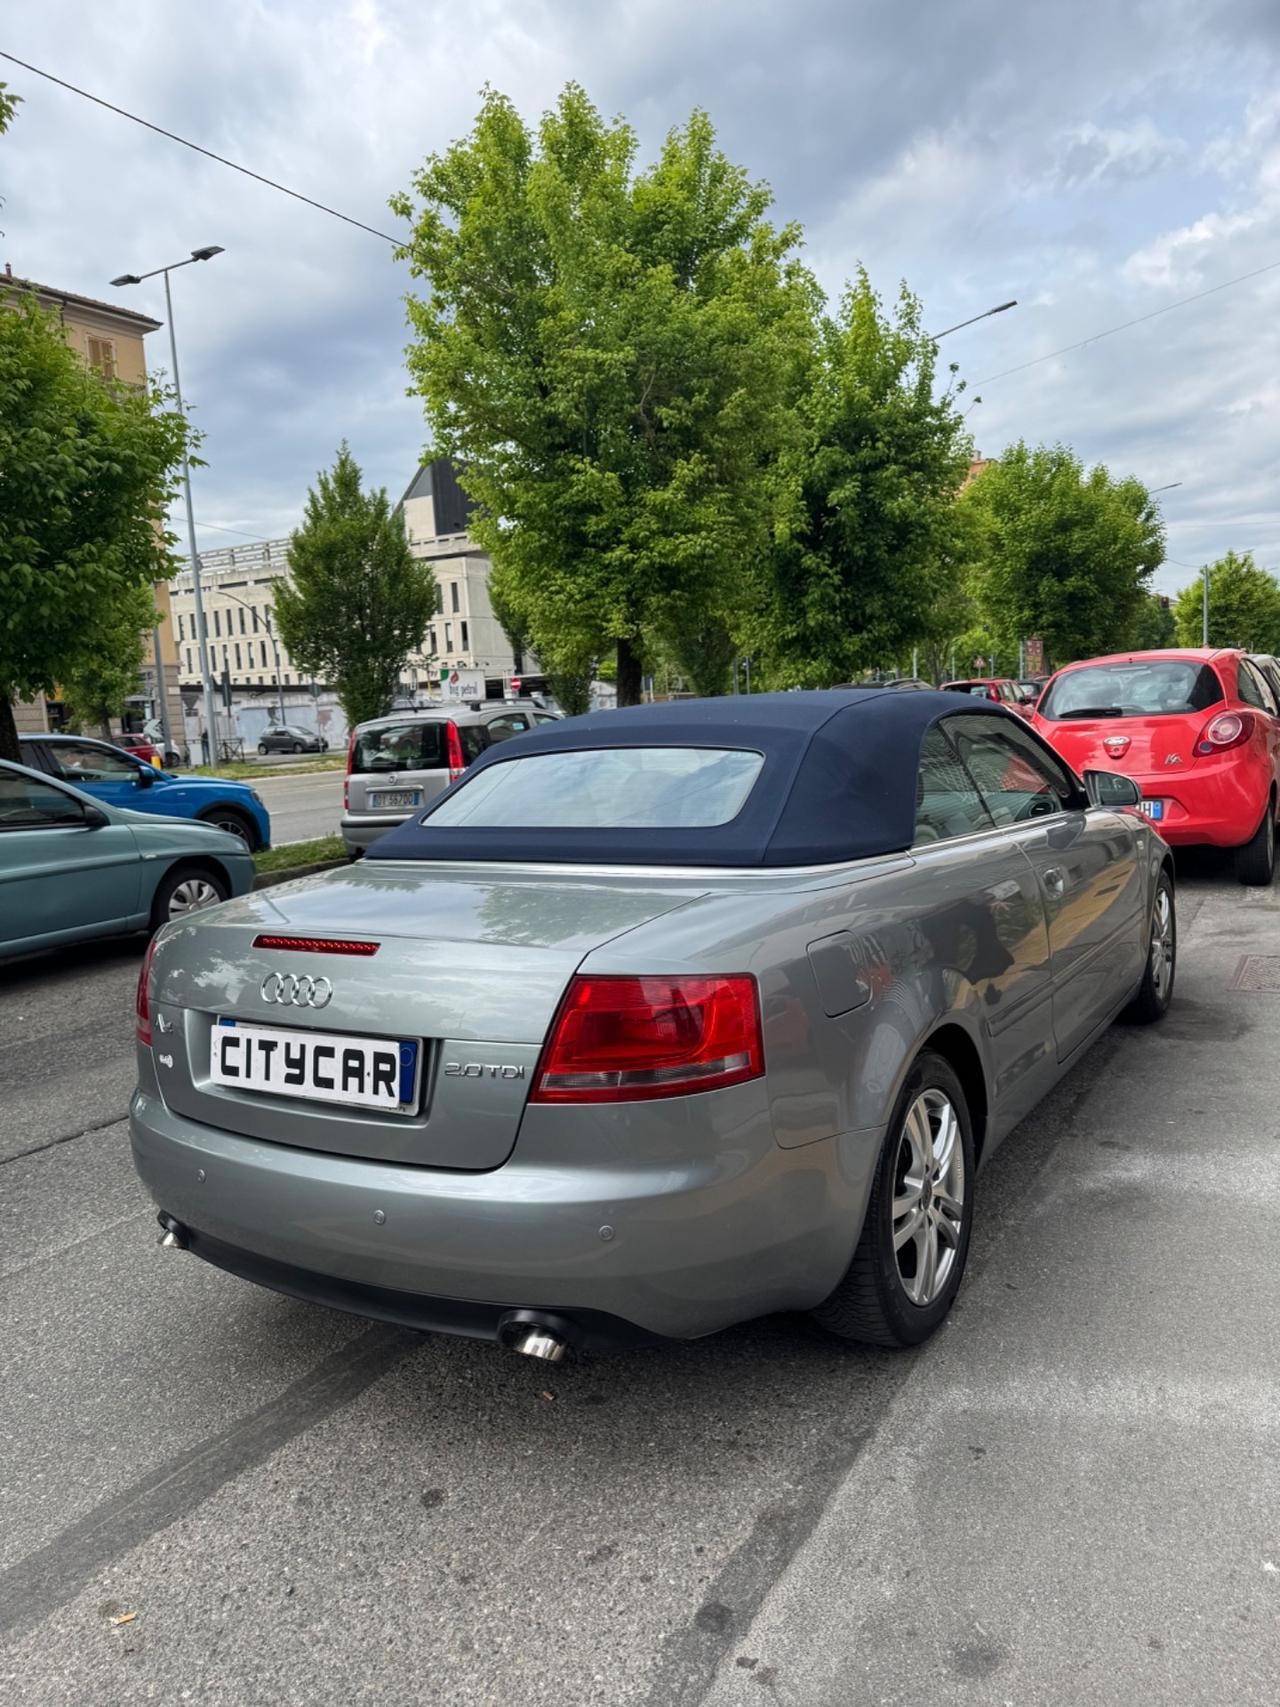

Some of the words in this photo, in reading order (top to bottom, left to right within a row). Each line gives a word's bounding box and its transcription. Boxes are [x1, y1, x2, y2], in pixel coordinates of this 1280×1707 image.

[220, 1036, 397, 1098] CITYCAR
[444, 1062, 482, 1078] 2.0
[484, 1064, 525, 1080] TDI
